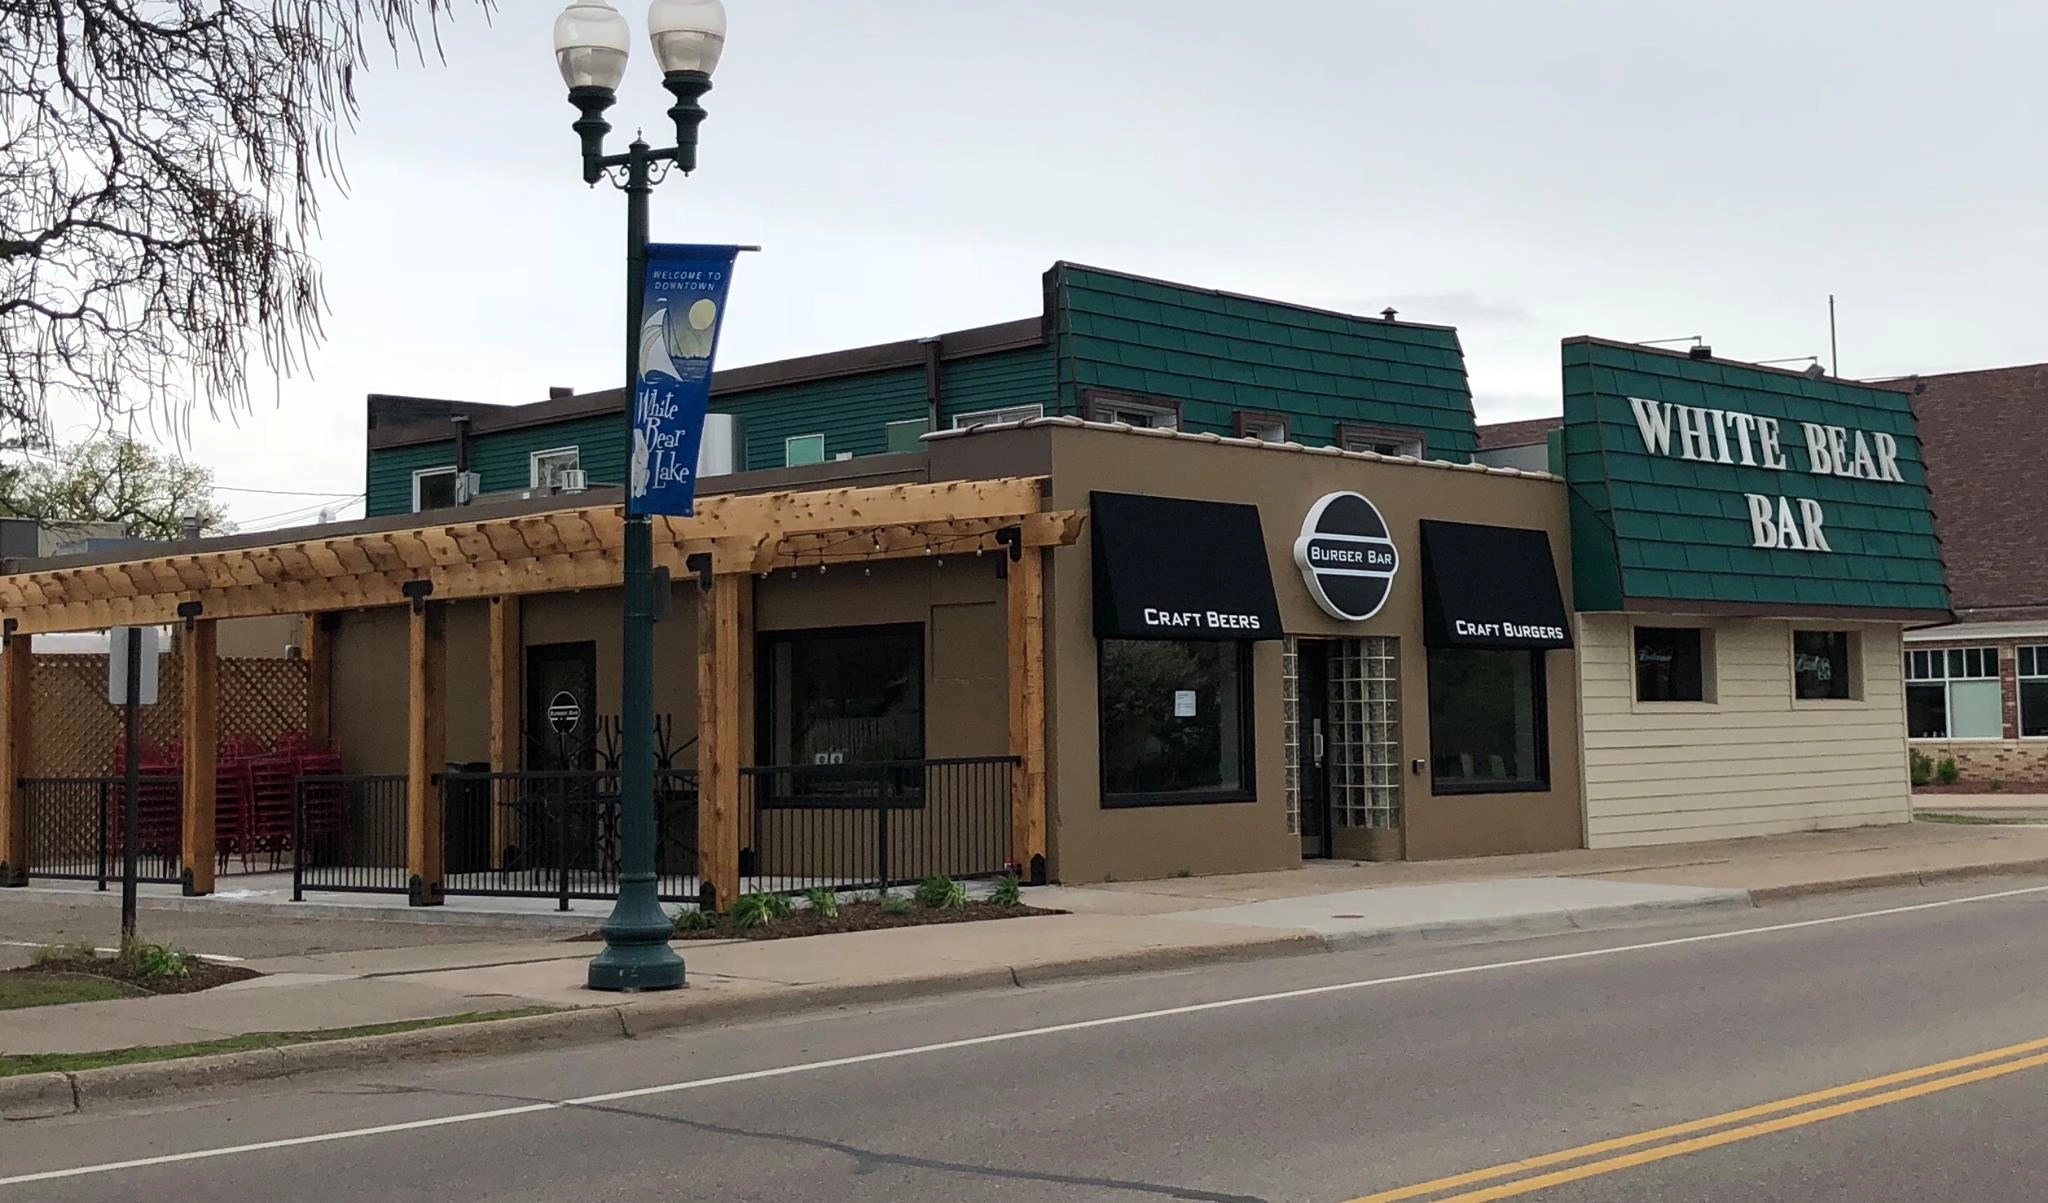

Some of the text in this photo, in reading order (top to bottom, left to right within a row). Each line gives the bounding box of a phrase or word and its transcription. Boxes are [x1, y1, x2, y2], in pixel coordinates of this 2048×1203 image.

[653, 271, 721, 280] WELCOME TO
[655, 281, 715, 291] DOWNTOWN
[637, 388, 679, 424] White
[646, 417, 686, 453] Bear
[1627, 397, 1905, 482] WHITE BEAR
[652, 450, 690, 489] Lake
[1744, 493, 1832, 551] BAR
[1311, 546, 1392, 565] BURGER BAR
[1144, 608, 1261, 629] CRAFT BEERS
[1455, 620, 1564, 639] CRAFT BURGERS
